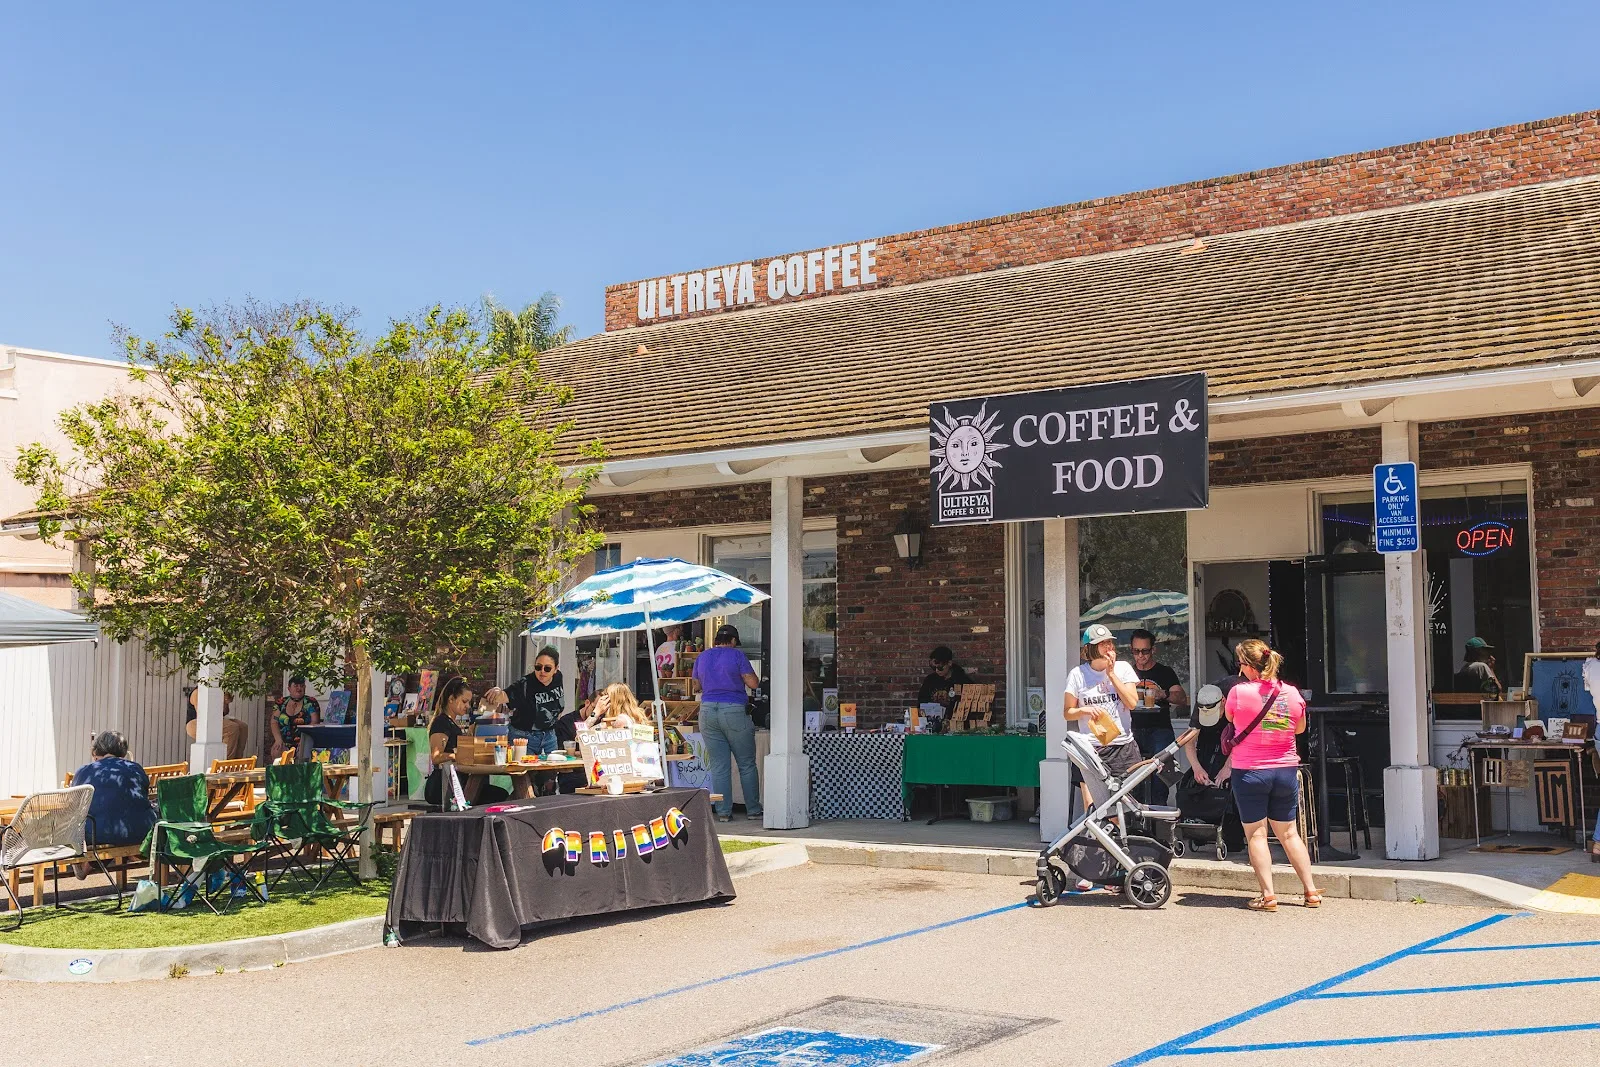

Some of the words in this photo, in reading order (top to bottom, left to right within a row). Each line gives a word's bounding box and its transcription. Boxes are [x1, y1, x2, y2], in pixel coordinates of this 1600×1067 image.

[637, 263, 755, 320] ULTREYA
[767, 242, 877, 300] COFFEE
[1013, 402, 1160, 447] COFFEE
[1168, 398, 1200, 433] &
[1052, 454, 1164, 494] FOOD
[943, 495, 989, 508] ULTREYA
[1382, 495, 1409, 503] PARKING
[943, 508, 967, 517] COFFEE
[969, 507, 974, 515] &
[976, 506, 990, 515] TEA
[1379, 516, 1414, 524] ACCESSIBLE
[1382, 528, 1411, 537] MINIMUM
[1456, 528, 1514, 549] OPEN
[1379, 538, 1394, 547] FINE
[1397, 537, 1415, 546] $250
[1083, 693, 1121, 706] BASKETBA
